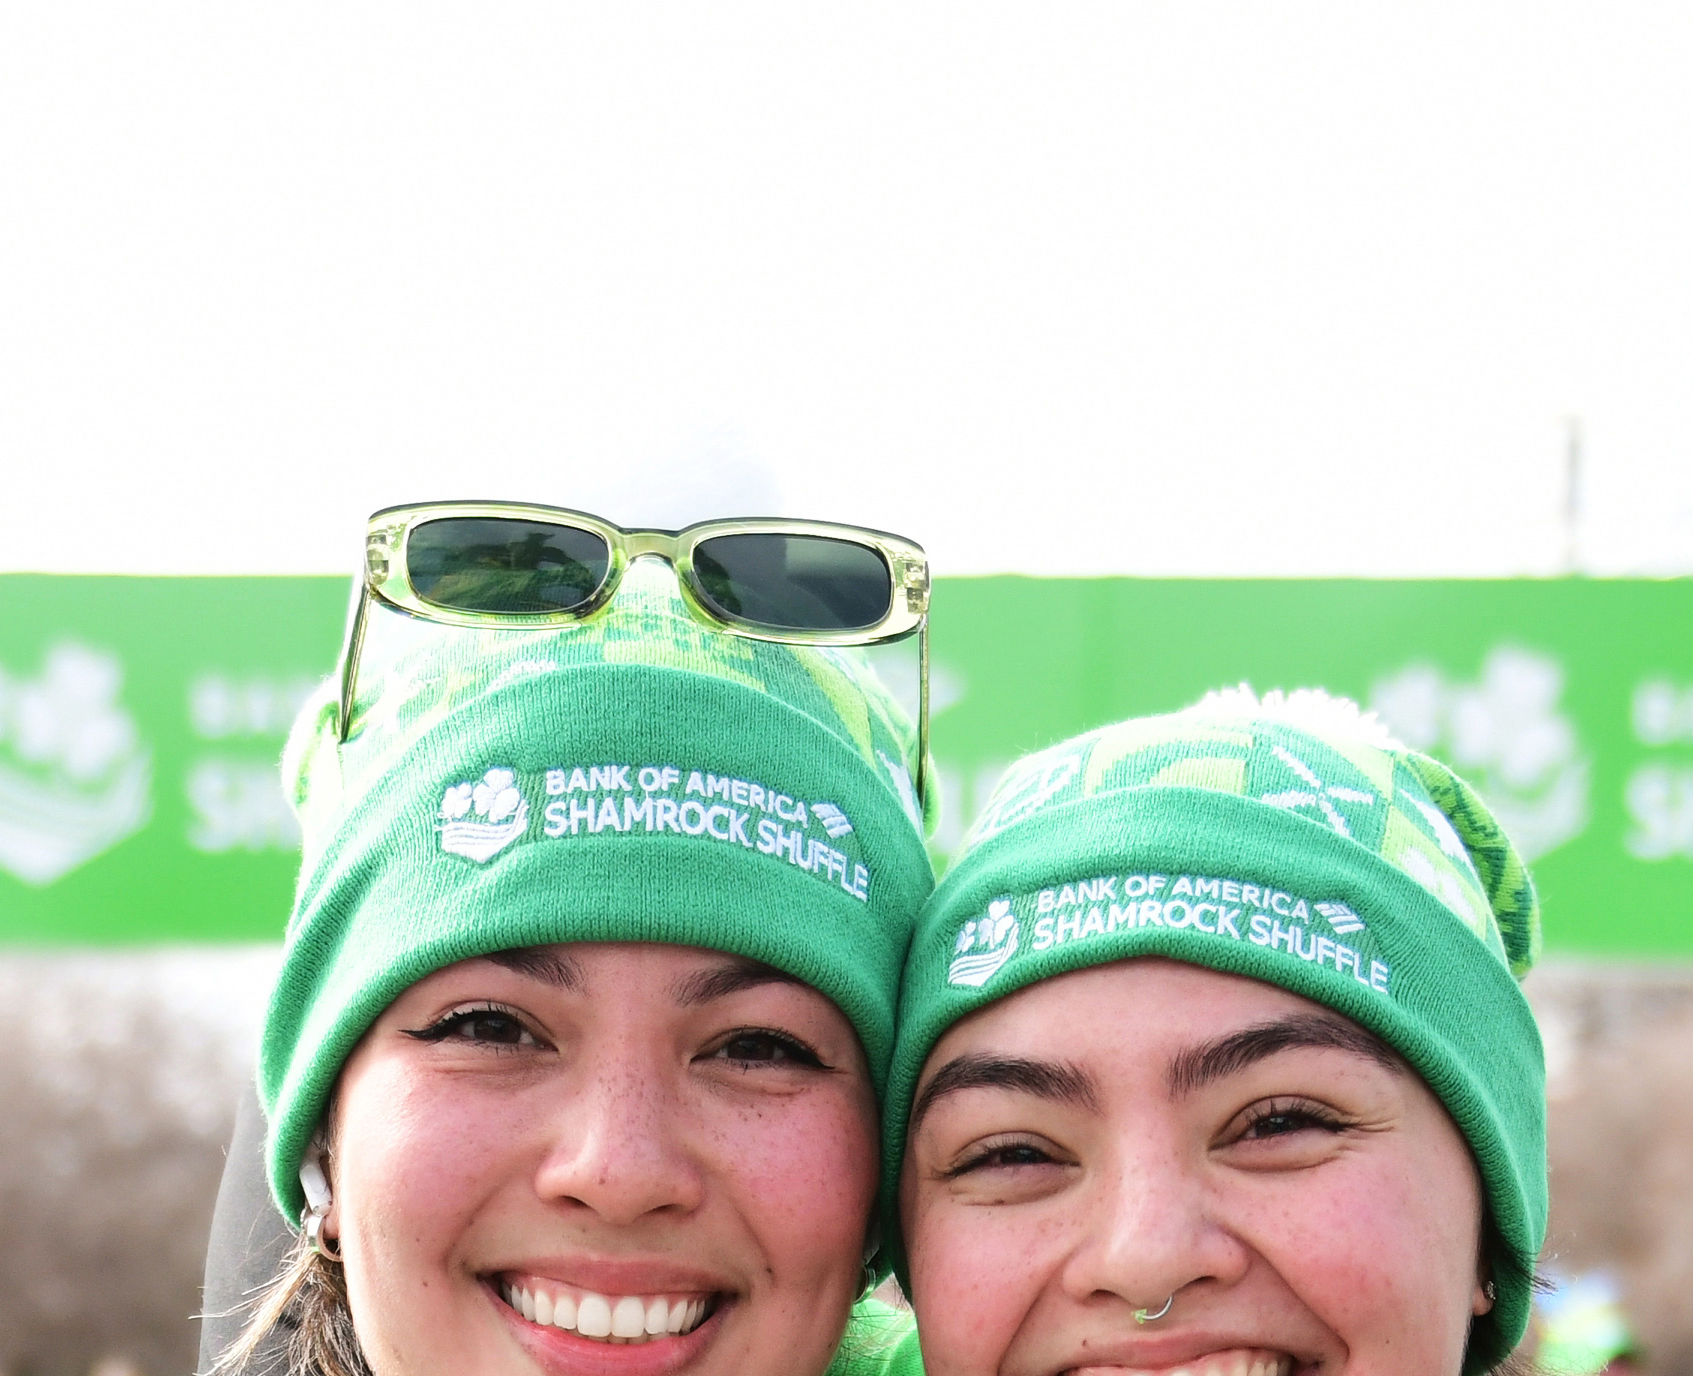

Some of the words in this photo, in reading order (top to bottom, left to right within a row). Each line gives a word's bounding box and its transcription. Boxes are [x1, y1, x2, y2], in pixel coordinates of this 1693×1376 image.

[546, 765, 632, 795] BANK
[638, 766, 679, 792] OF
[685, 772, 808, 828] AMERICA
[544, 797, 753, 848] SHAMROCK
[756, 819, 869, 903] SHUFFLE
[1038, 877, 1117, 913] BANK
[1124, 875, 1166, 897] OF
[1171, 876, 1308, 924] AMERICA
[1032, 900, 1240, 950] SHAMROCK
[1248, 915, 1389, 995] SHUFFLE
